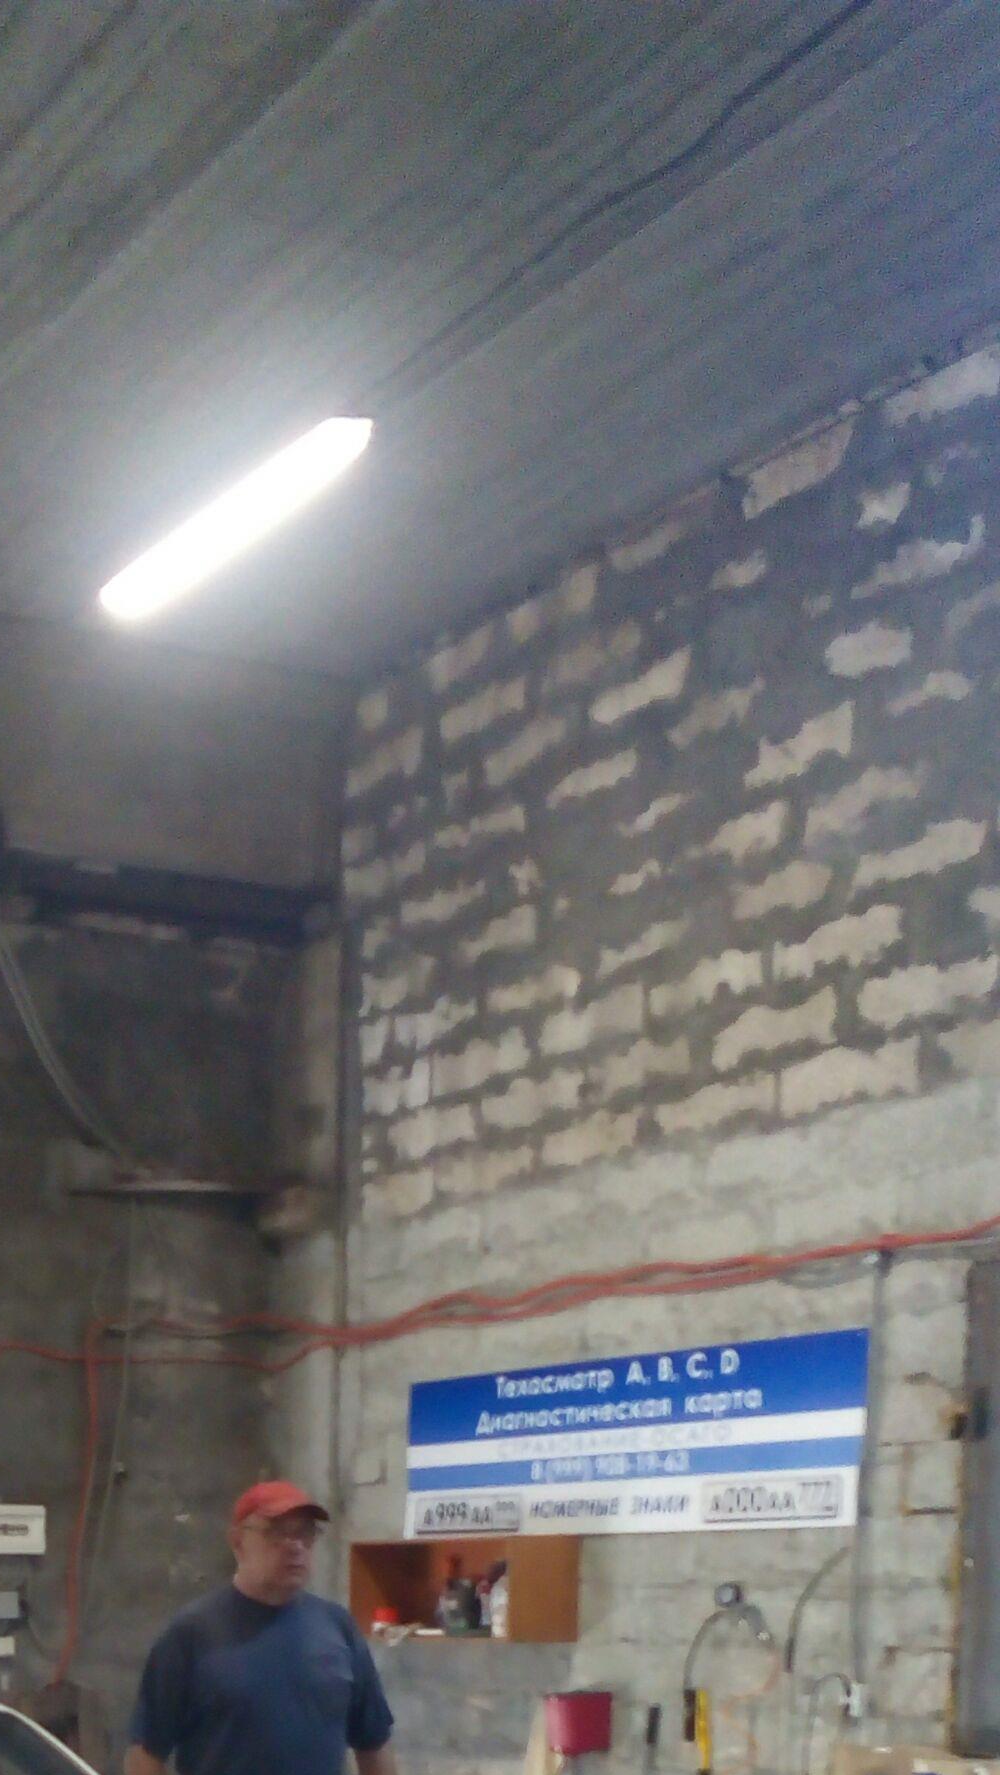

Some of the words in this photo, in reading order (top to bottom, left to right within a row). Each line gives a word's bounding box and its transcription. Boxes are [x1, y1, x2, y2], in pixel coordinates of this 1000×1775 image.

[496, 1368, 615, 1399] Техосмотр
[719, 1348, 741, 1375] D
[475, 1398, 672, 1437] Диагностическая
[684, 1388, 763, 1418] карта
[529, 1495, 619, 1519] НОМЕРНЫЕ
[629, 1493, 691, 1516] ЗНАКИ
